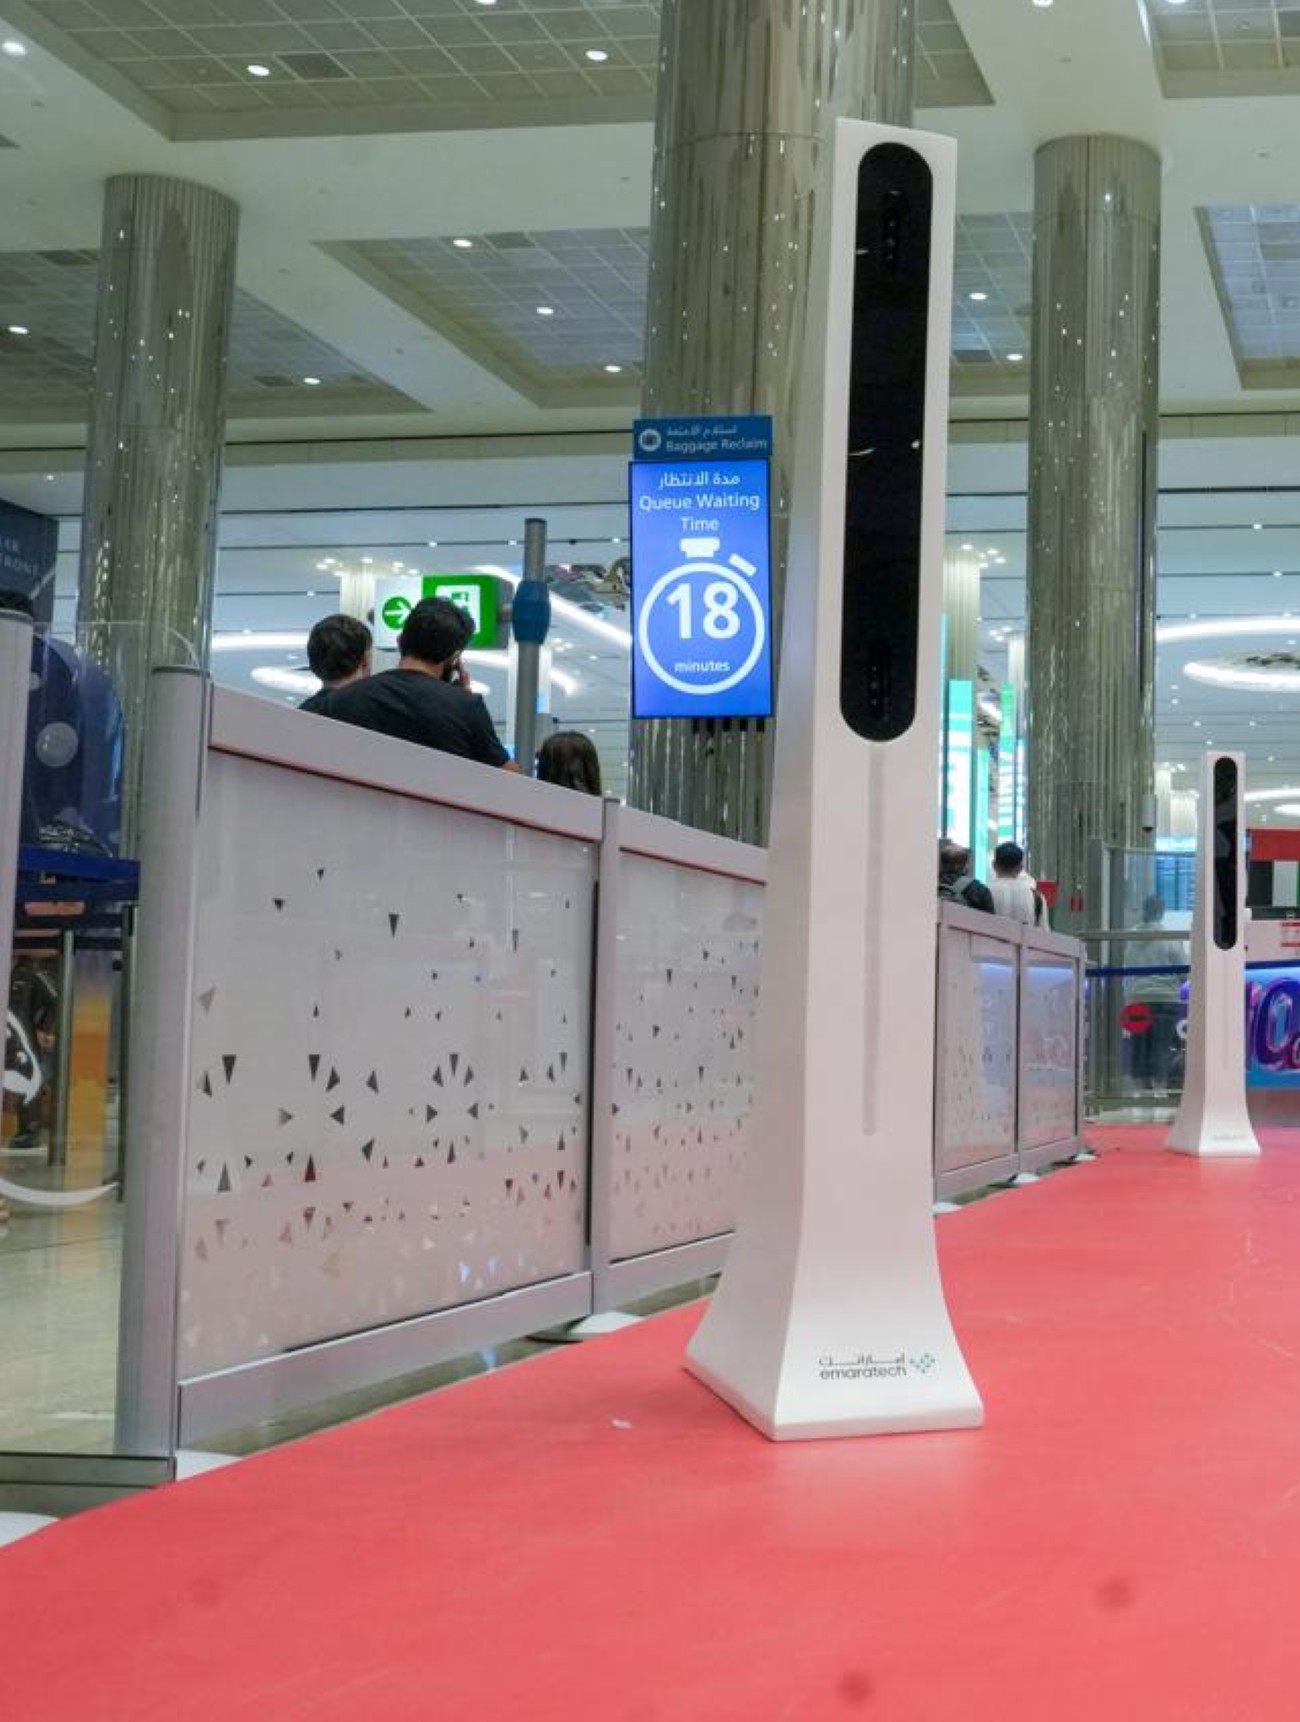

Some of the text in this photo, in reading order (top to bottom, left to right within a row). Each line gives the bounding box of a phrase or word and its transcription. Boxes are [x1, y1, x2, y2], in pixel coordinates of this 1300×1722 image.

[665, 437, 767, 454] Baggage Reclaim
[713, 472, 741, 485] مدة
[640, 492, 760, 513] Queue Waiting
[680, 515, 720, 532] Time
[665, 582, 741, 640] 18
[674, 660, 732, 673] minutes
[819, 1365, 908, 1380] emaratech
